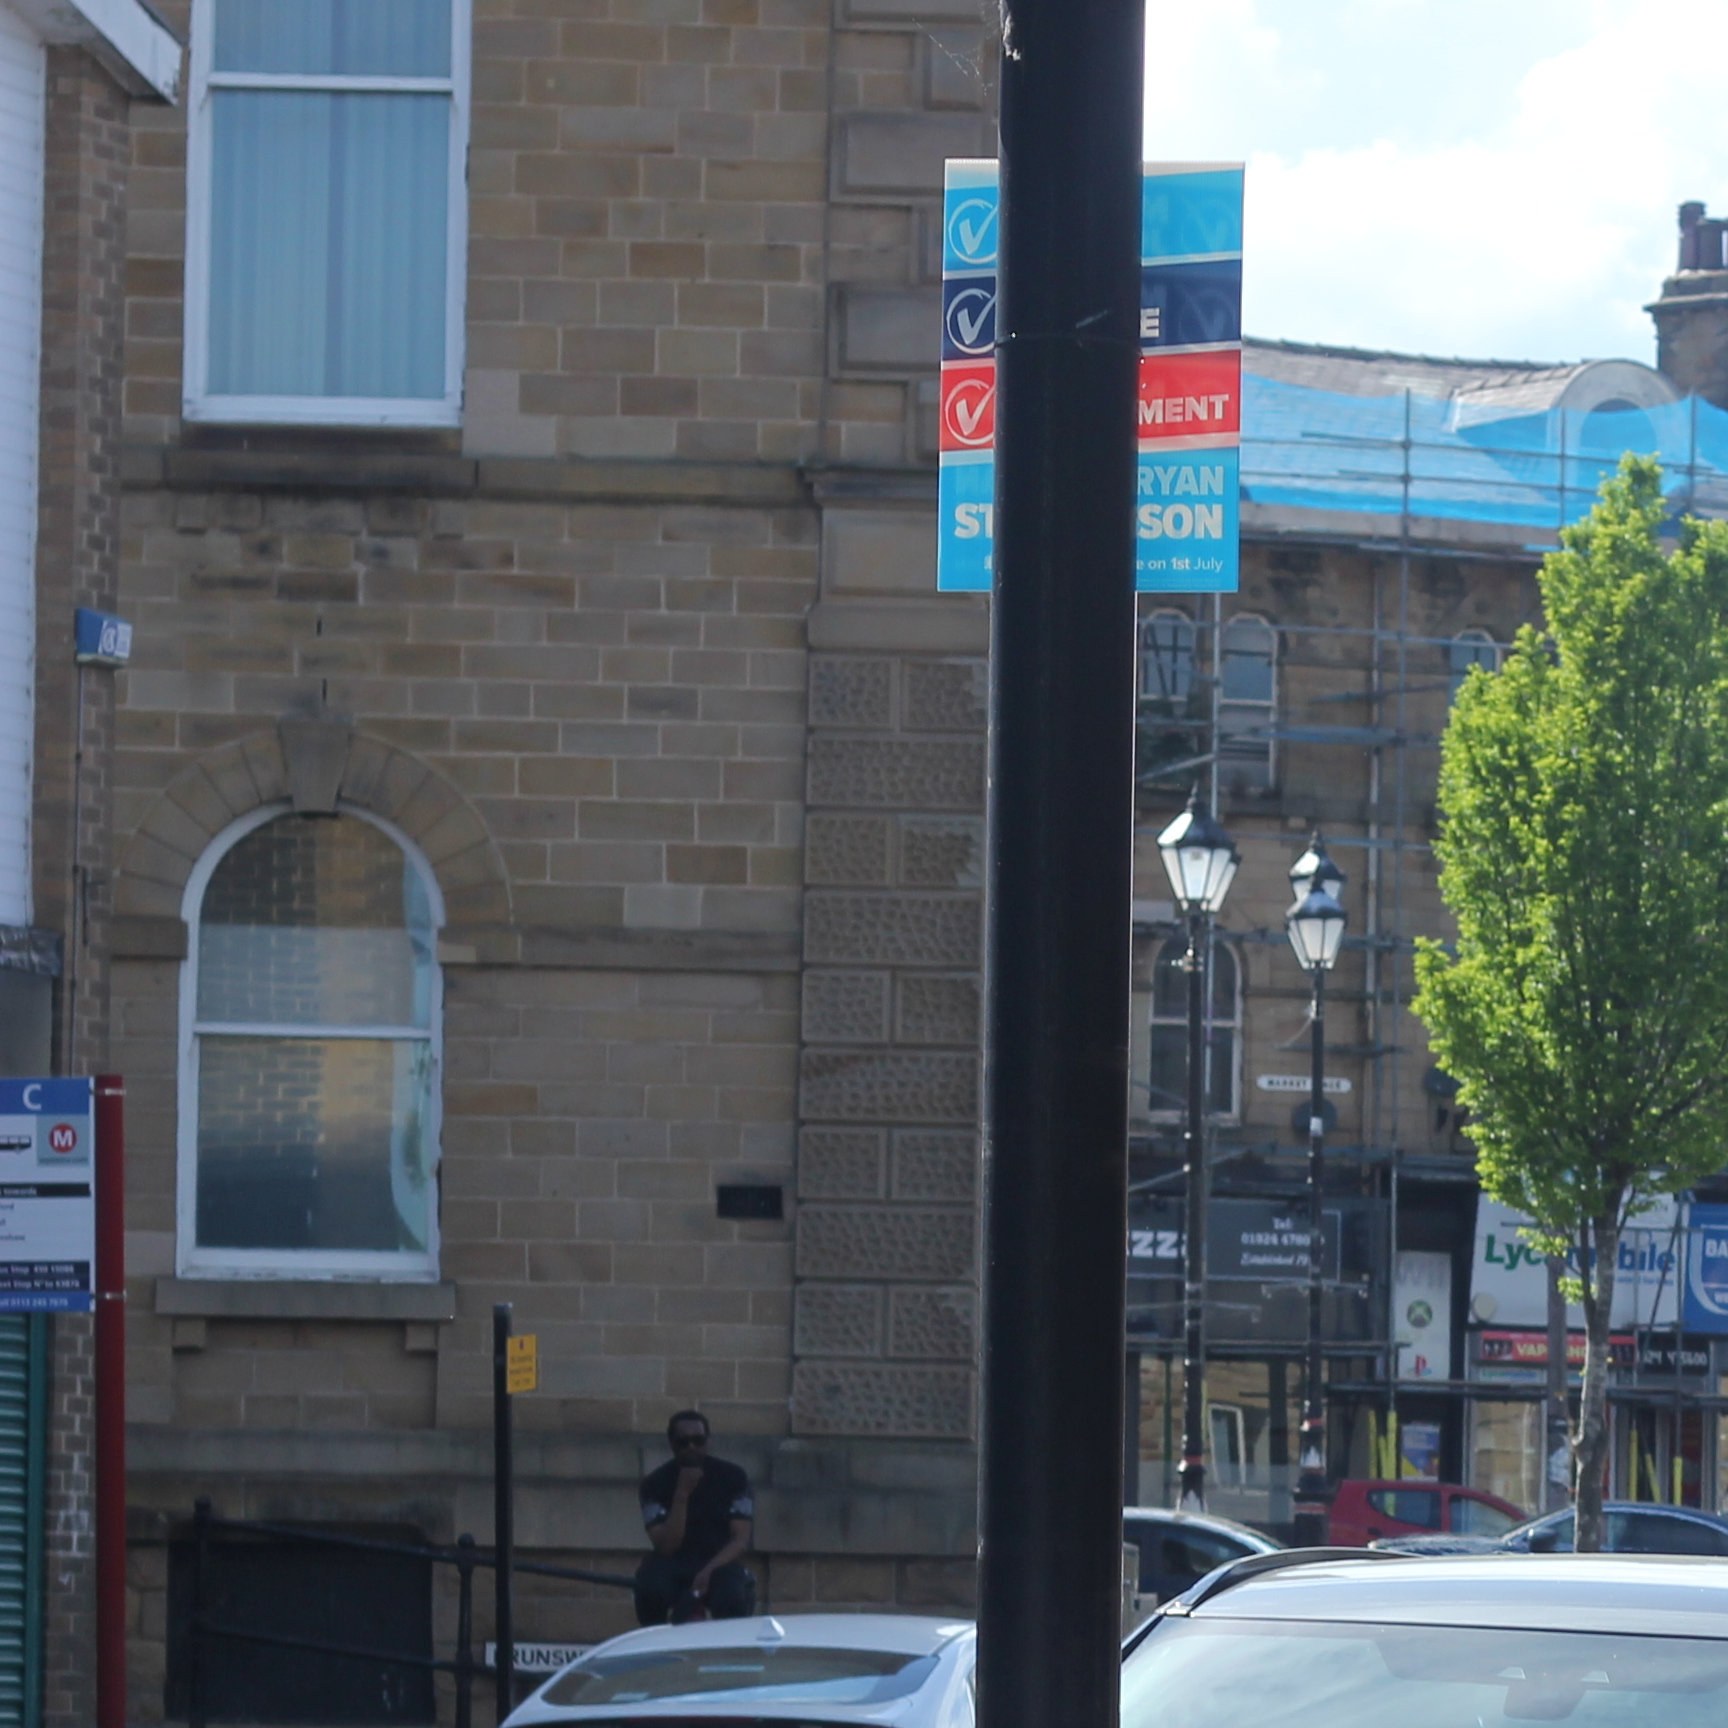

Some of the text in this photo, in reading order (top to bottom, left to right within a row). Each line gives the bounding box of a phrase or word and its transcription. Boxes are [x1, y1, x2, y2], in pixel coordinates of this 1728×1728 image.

[1148, 559, 1166, 570] on
[1171, 557, 1191, 570] 1st
[1193, 557, 1223, 573] July
[23, 1083, 42, 1111] C
[53, 1129, 74, 1148] M
